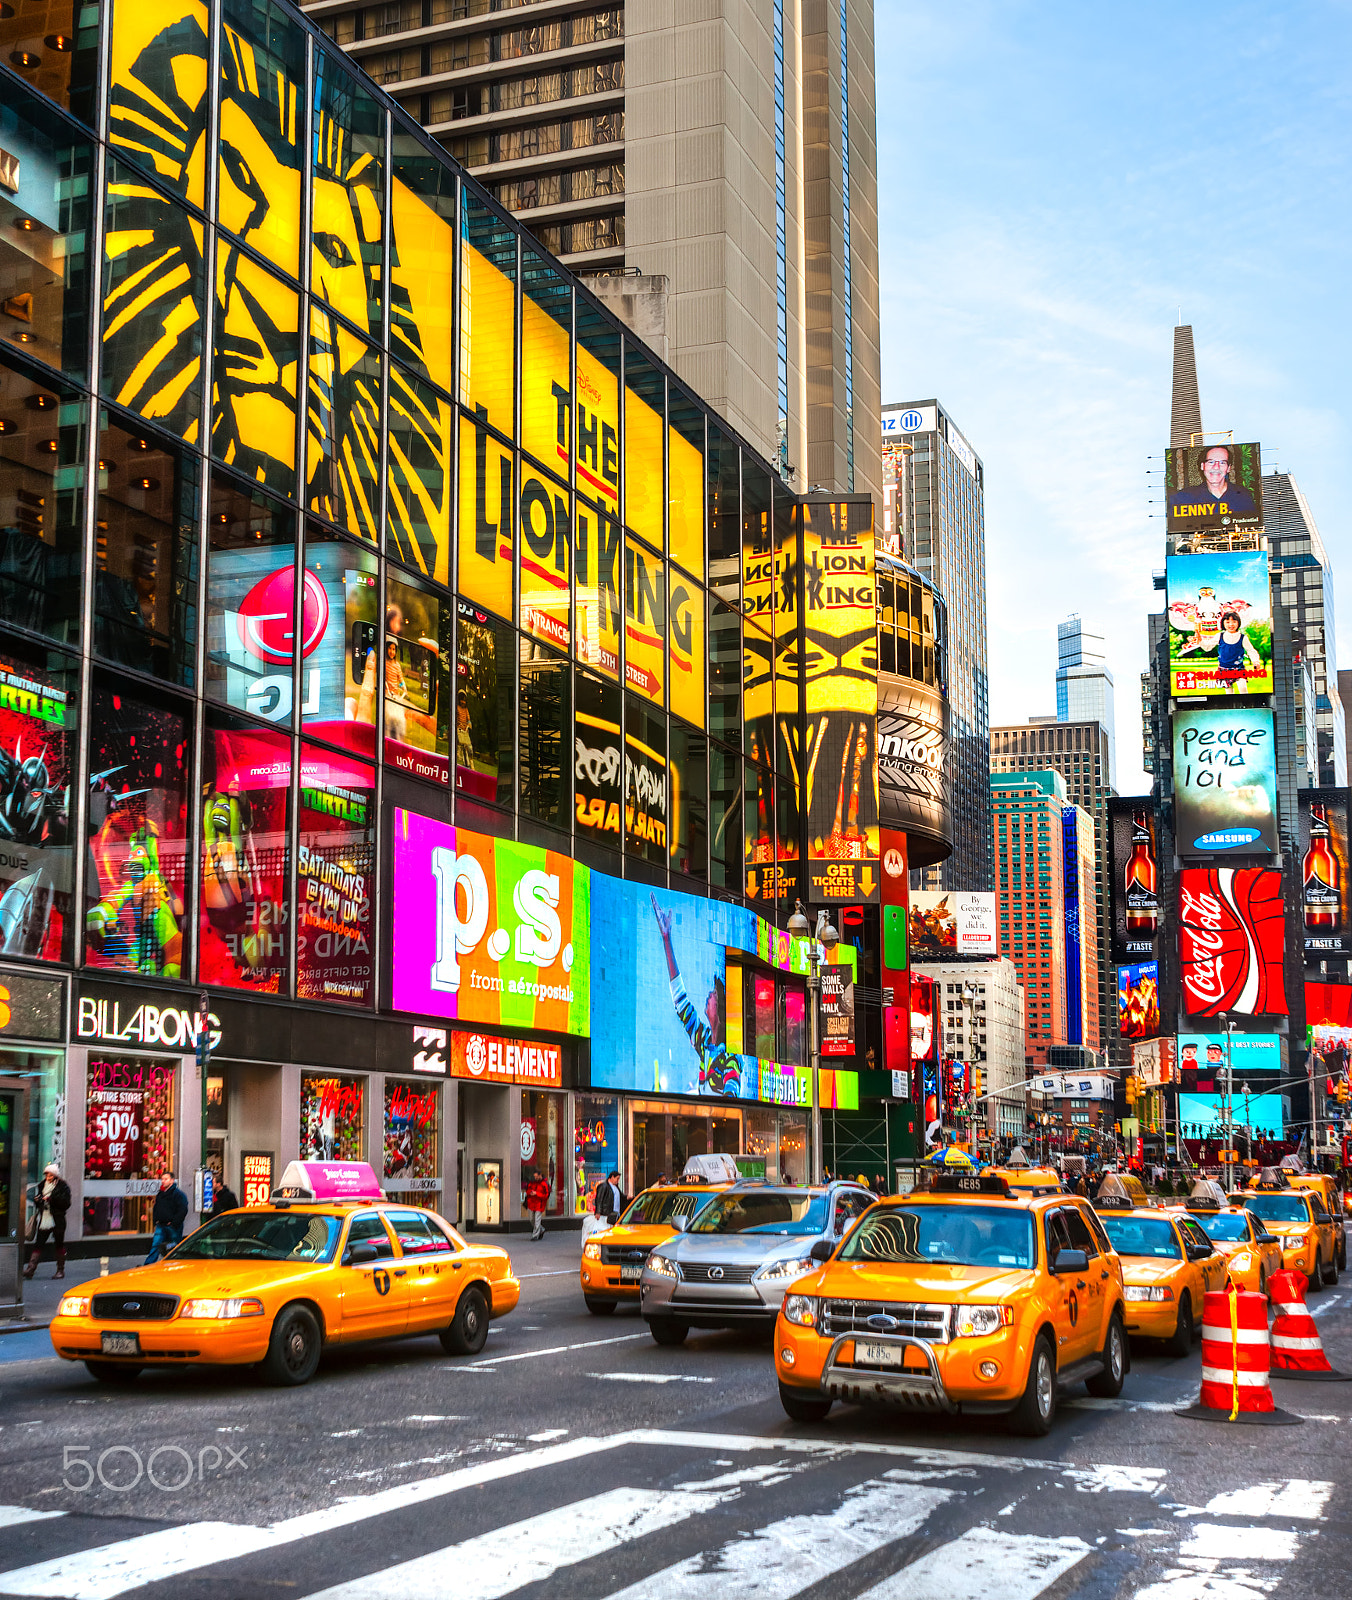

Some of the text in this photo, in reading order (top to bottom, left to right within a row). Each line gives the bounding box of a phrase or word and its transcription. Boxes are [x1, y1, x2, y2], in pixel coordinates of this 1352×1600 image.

[552, 382, 617, 486] THE
[475, 401, 588, 587] LION
[1173, 502, 1232, 517] LENNY B.
[597, 496, 692, 656] KING
[807, 580, 873, 610] KING
[525, 606, 570, 644] ENTRANCE
[579, 638, 592, 654] ON
[626, 666, 648, 688] STREET
[1197, 679, 1228, 689] CHINA
[1198, 747, 1246, 767] and
[301, 787, 366, 825] TURTLES
[1202, 833, 1252, 844] SAMSUNG
[299, 846, 364, 904] SATURDAYS
[826, 864, 855, 877] GET
[812, 876, 855, 886] TICKETS
[823, 886, 855, 897] HERE
[971, 896, 981, 905] By
[343, 901, 359, 923] ON
[431, 846, 574, 993] p.s.
[303, 911, 362, 940] nickelodeon
[966, 921, 978, 929] did
[1126, 943, 1152, 951] #TASTE
[1305, 939, 1342, 948] #TASTE IS
[470, 970, 574, 1002] from aéropostale
[822, 975, 840, 985] SOME
[822, 985, 844, 994] WALLS
[822, 994, 836, 1004] CAN
[823, 1003, 839, 1013] TALK
[78, 997, 223, 1050] BILLABONG
[488, 1042, 557, 1079] ELEMENT
[91, 1062, 131, 1087] TIDES
[94, 1091, 143, 1104] ENTIRE STORE
[319, 1080, 363, 1125] HAPPY
[389, 1086, 437, 1128] HOLIDAYS
[96, 1112, 139, 1141] 50%
[108, 1143, 126, 1157] OFF
[244, 1156, 271, 1165] ENTIRE
[244, 1165, 271, 1175] STORE
[410, 1179, 436, 1189] BILLABONG
[958, 1178, 980, 1189] 4E85
[246, 1183, 269, 1202] 50
